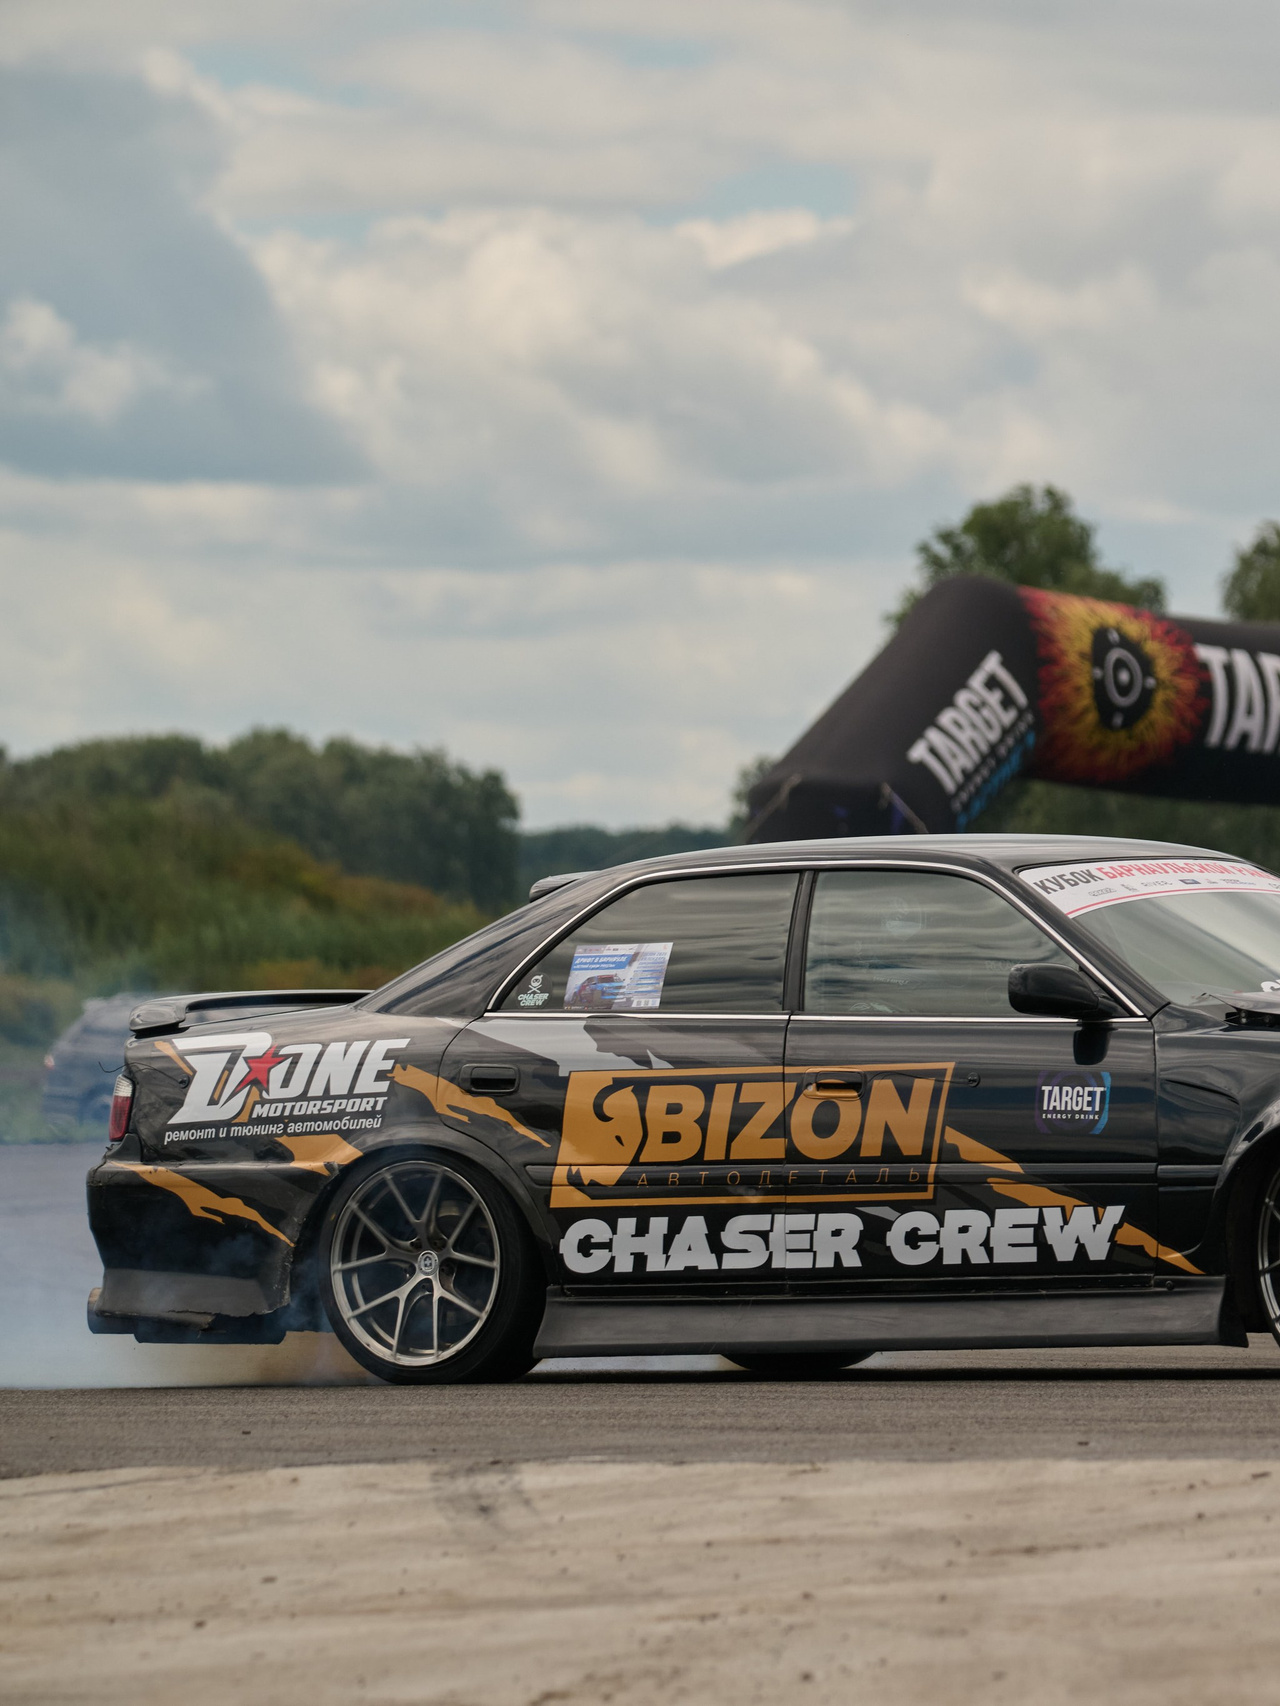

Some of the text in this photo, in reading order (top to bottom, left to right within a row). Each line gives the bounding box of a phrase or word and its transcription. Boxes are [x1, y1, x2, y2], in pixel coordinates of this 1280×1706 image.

[907, 650, 1028, 795] TARGET
[1033, 868, 1104, 895] КУБОК
[1096, 861, 1235, 880] БАРНАУЛЬСКОЙ
[517, 993, 549, 1001] CHASER
[251, 1096, 388, 1119] MOTORSPORT
[1041, 1086, 1105, 1111] TARGET
[164, 1114, 383, 1145] ремонт и тюнинг автомобилей
[639, 1078, 935, 1163] BIZON
[559, 1205, 1126, 1274] CHASER CREW
